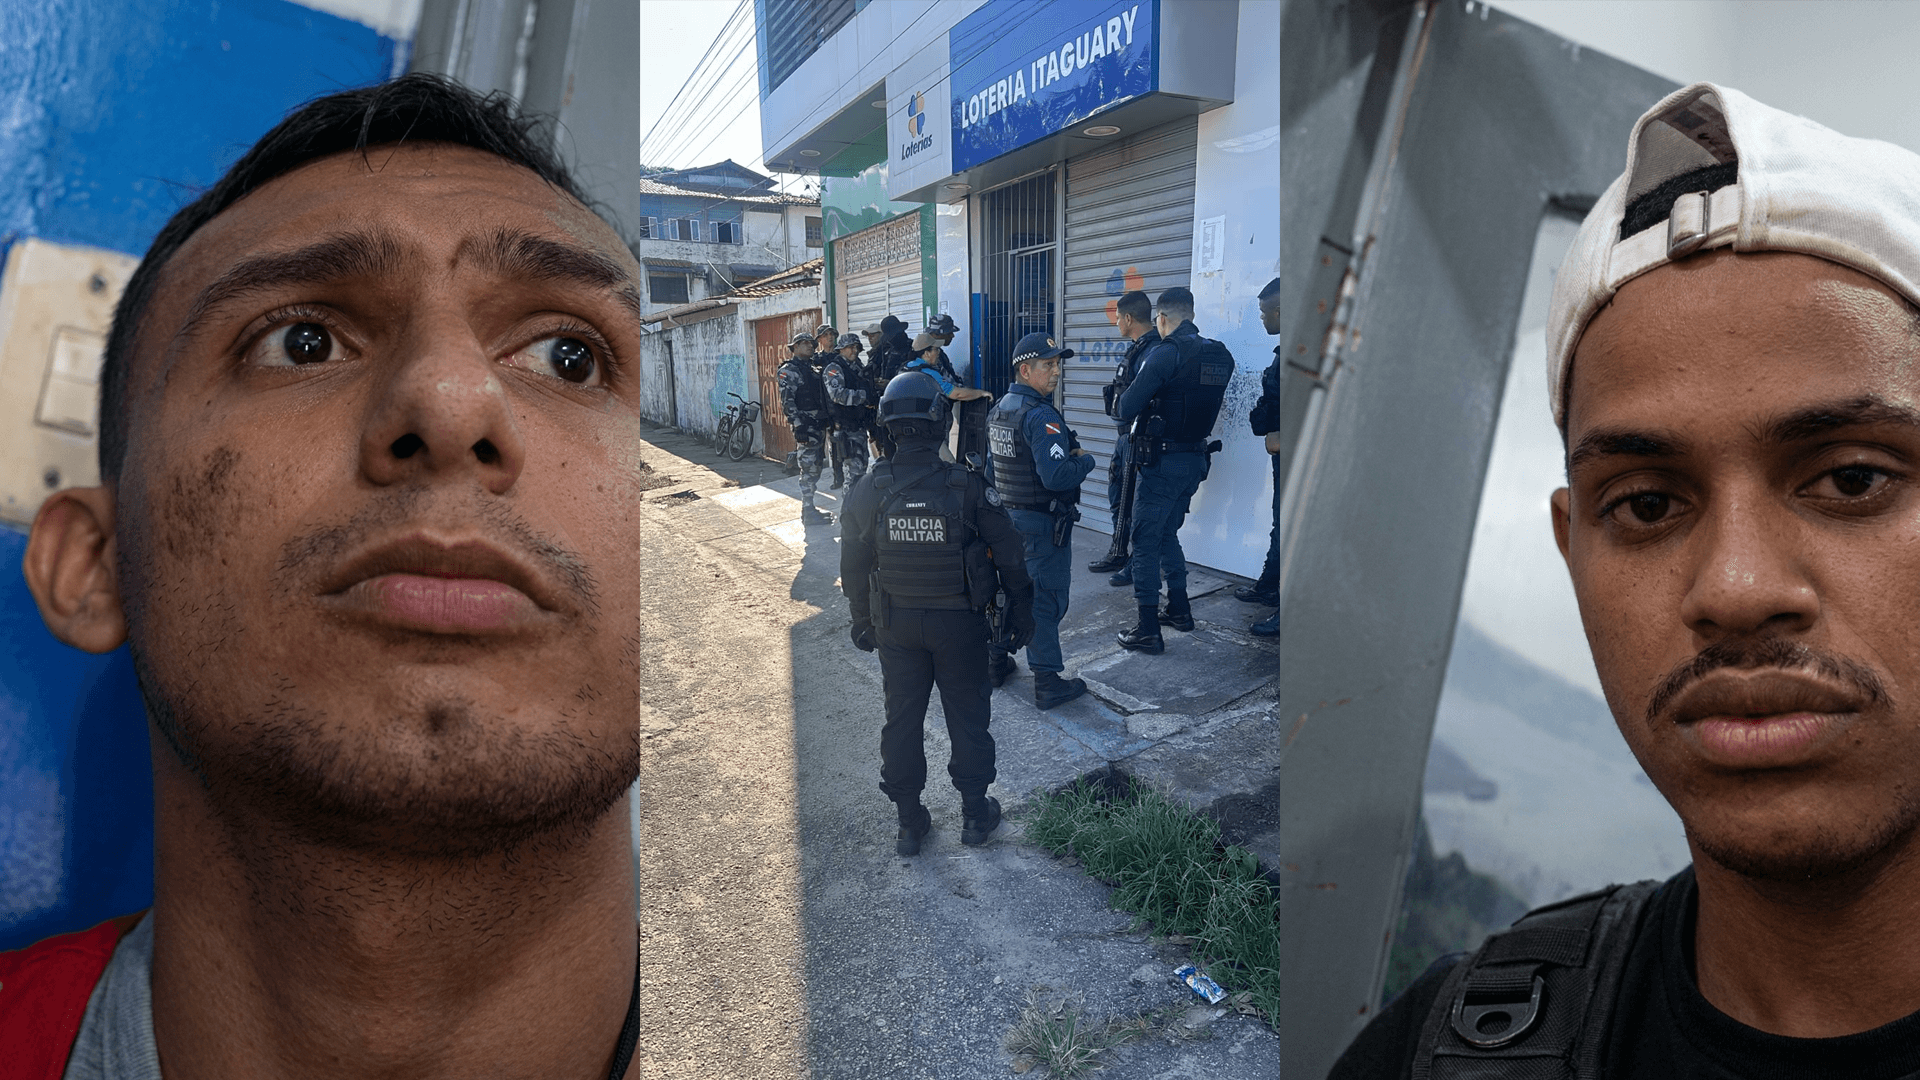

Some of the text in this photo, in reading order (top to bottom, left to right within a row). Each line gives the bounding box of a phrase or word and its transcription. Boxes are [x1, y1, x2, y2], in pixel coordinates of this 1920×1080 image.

[961, 5, 1139, 129] LOTERIA ITAGUARY
[901, 133, 933, 161] Loterias
[889, 516, 943, 530] POLÍCIA
[889, 530, 945, 542] MILITAR
